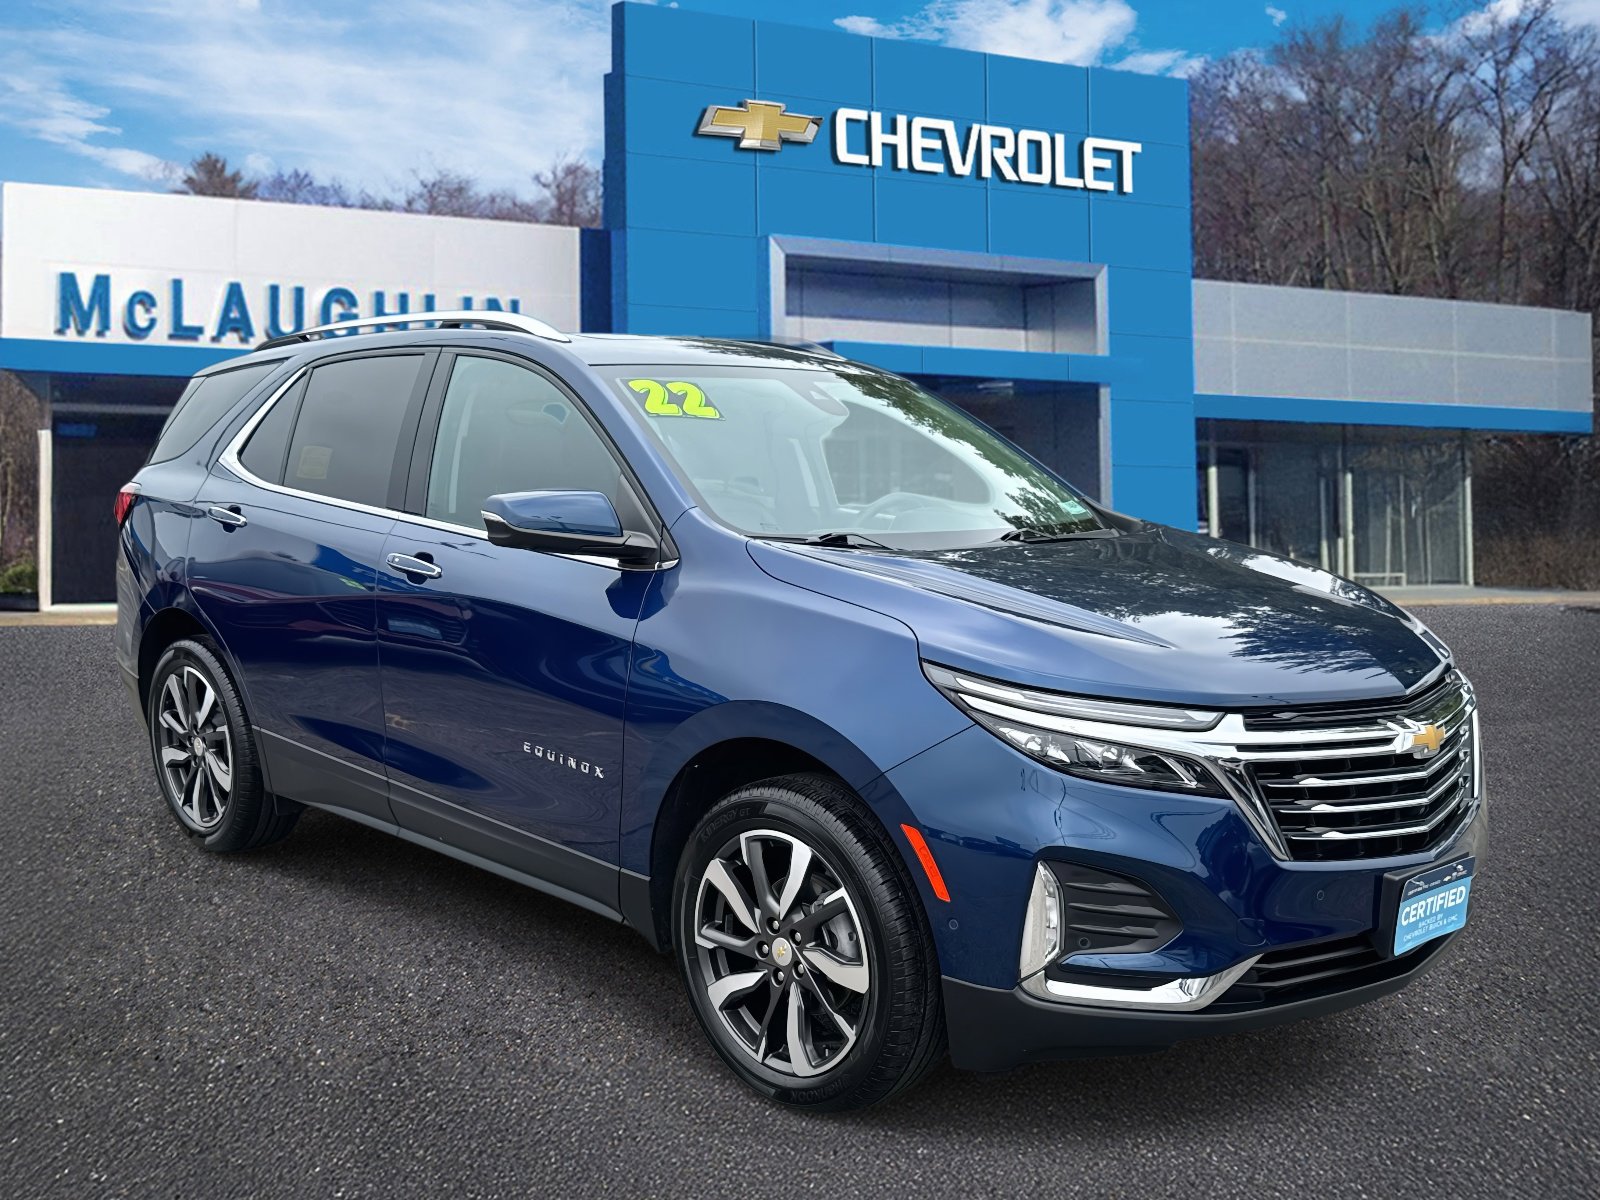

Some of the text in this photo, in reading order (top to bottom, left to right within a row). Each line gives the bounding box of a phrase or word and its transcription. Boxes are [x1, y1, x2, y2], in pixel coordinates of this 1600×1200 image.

[835, 107, 1142, 194] CHEVROLET
[628, 378, 720, 419] 22
[523, 741, 605, 779] EQUINOX
[1402, 886, 1466, 926] CERTIFIED
[1404, 925, 1428, 941] CHEVROLET
